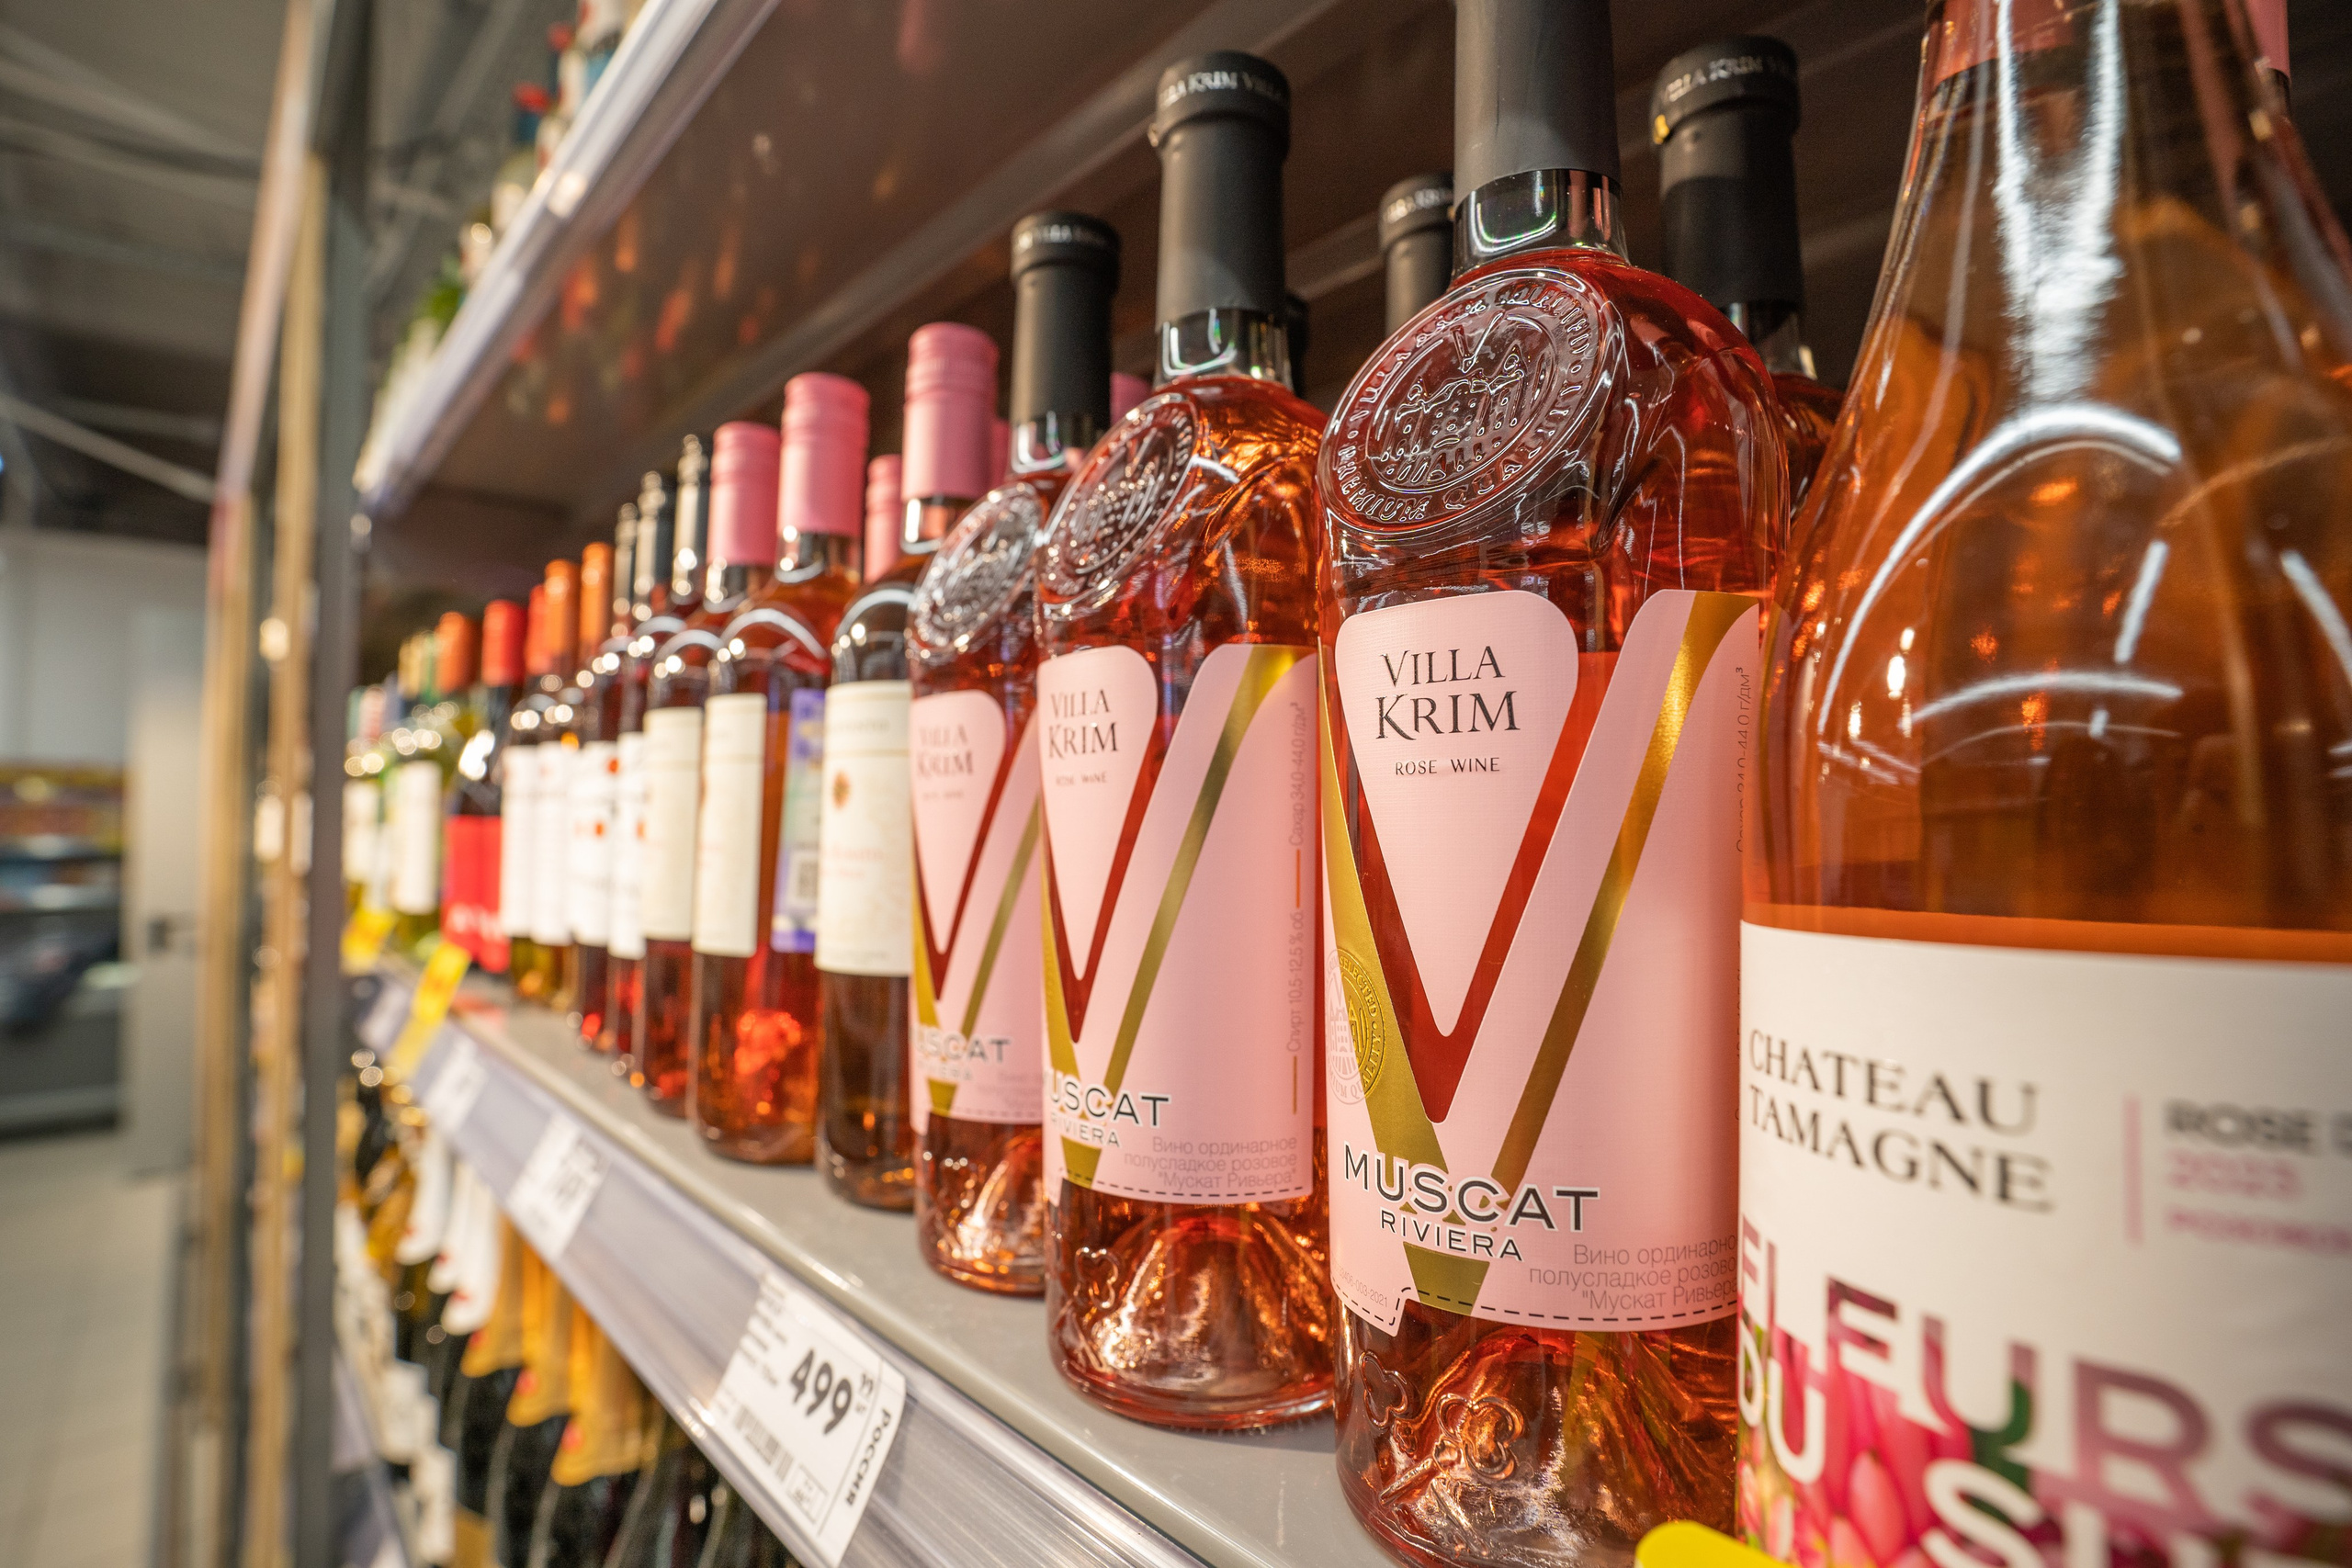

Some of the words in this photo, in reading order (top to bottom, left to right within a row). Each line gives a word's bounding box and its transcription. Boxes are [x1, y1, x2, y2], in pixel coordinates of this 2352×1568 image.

[1380, 645, 1507, 688] VILLA
[1051, 689, 1110, 719] VILLA
[1375, 690, 1521, 740] KRIM
[1048, 721, 1120, 760] KRIM
[1395, 759, 1439, 776] ROSE
[1451, 756, 1501, 773] WINE
[1340, 955, 1379, 1018] SELECTED
[1748, 1027, 2039, 1139] CHATEAU
[1124, 1152, 1227, 1172] полусладкое
[1231, 1153, 1298, 1172] розовое
[1152, 1135, 1194, 1154] Вино
[1197, 1136, 1298, 1157] ординарное
[1749, 1084, 2056, 1215] TAMAGNE
[1343, 1142, 1600, 1232] MUSCAT
[1379, 1209, 1524, 1262] RIVIERA
[1574, 1244, 1631, 1266] Вино
[1529, 1268, 1672, 1292] полусладкое
[1582, 1289, 1668, 1315] "Мускат
[789, 1348, 853, 1436] 499
[1738, 1314, 1826, 1485] DU
[845, 1407, 892, 1507] РОССИЯ
